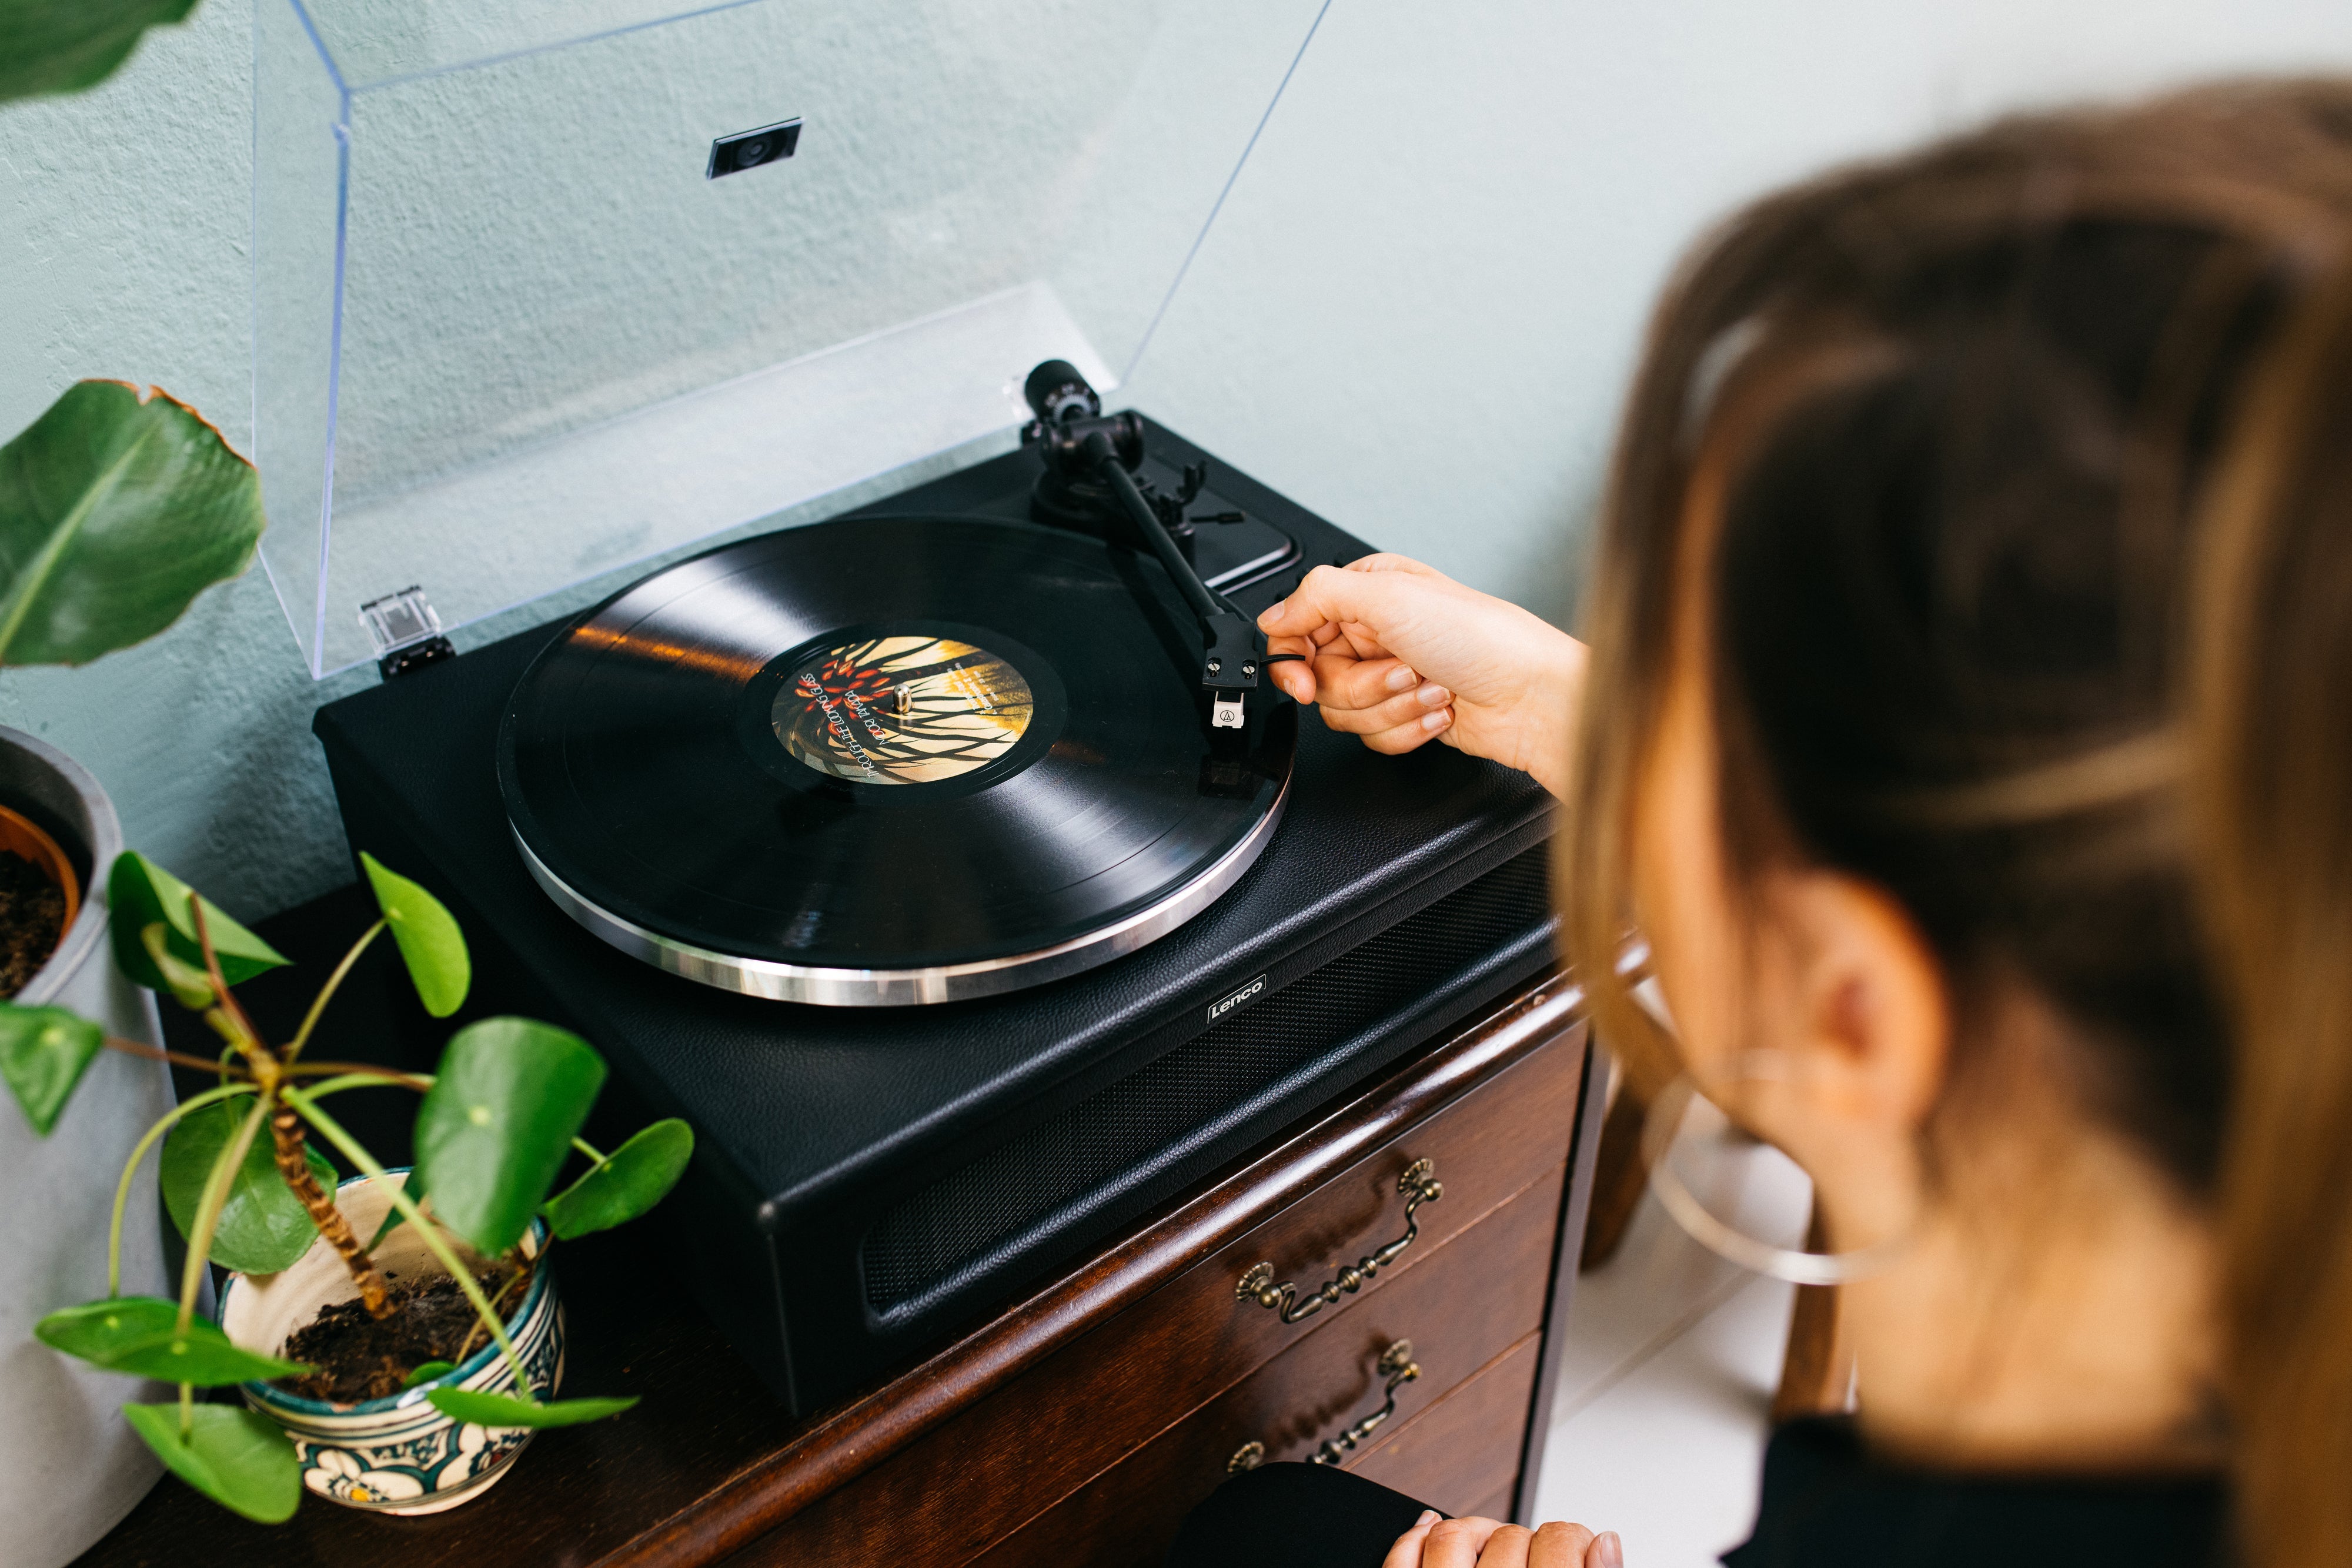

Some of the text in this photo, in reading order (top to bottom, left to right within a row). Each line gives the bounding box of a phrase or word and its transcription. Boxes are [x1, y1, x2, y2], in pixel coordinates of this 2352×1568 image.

[800, 673, 879, 778] THROUGH THE LOOKING GLASS
[844, 690, 890, 745] MIDORI TAKADA
[1211, 982, 1262, 1019] Lenco
